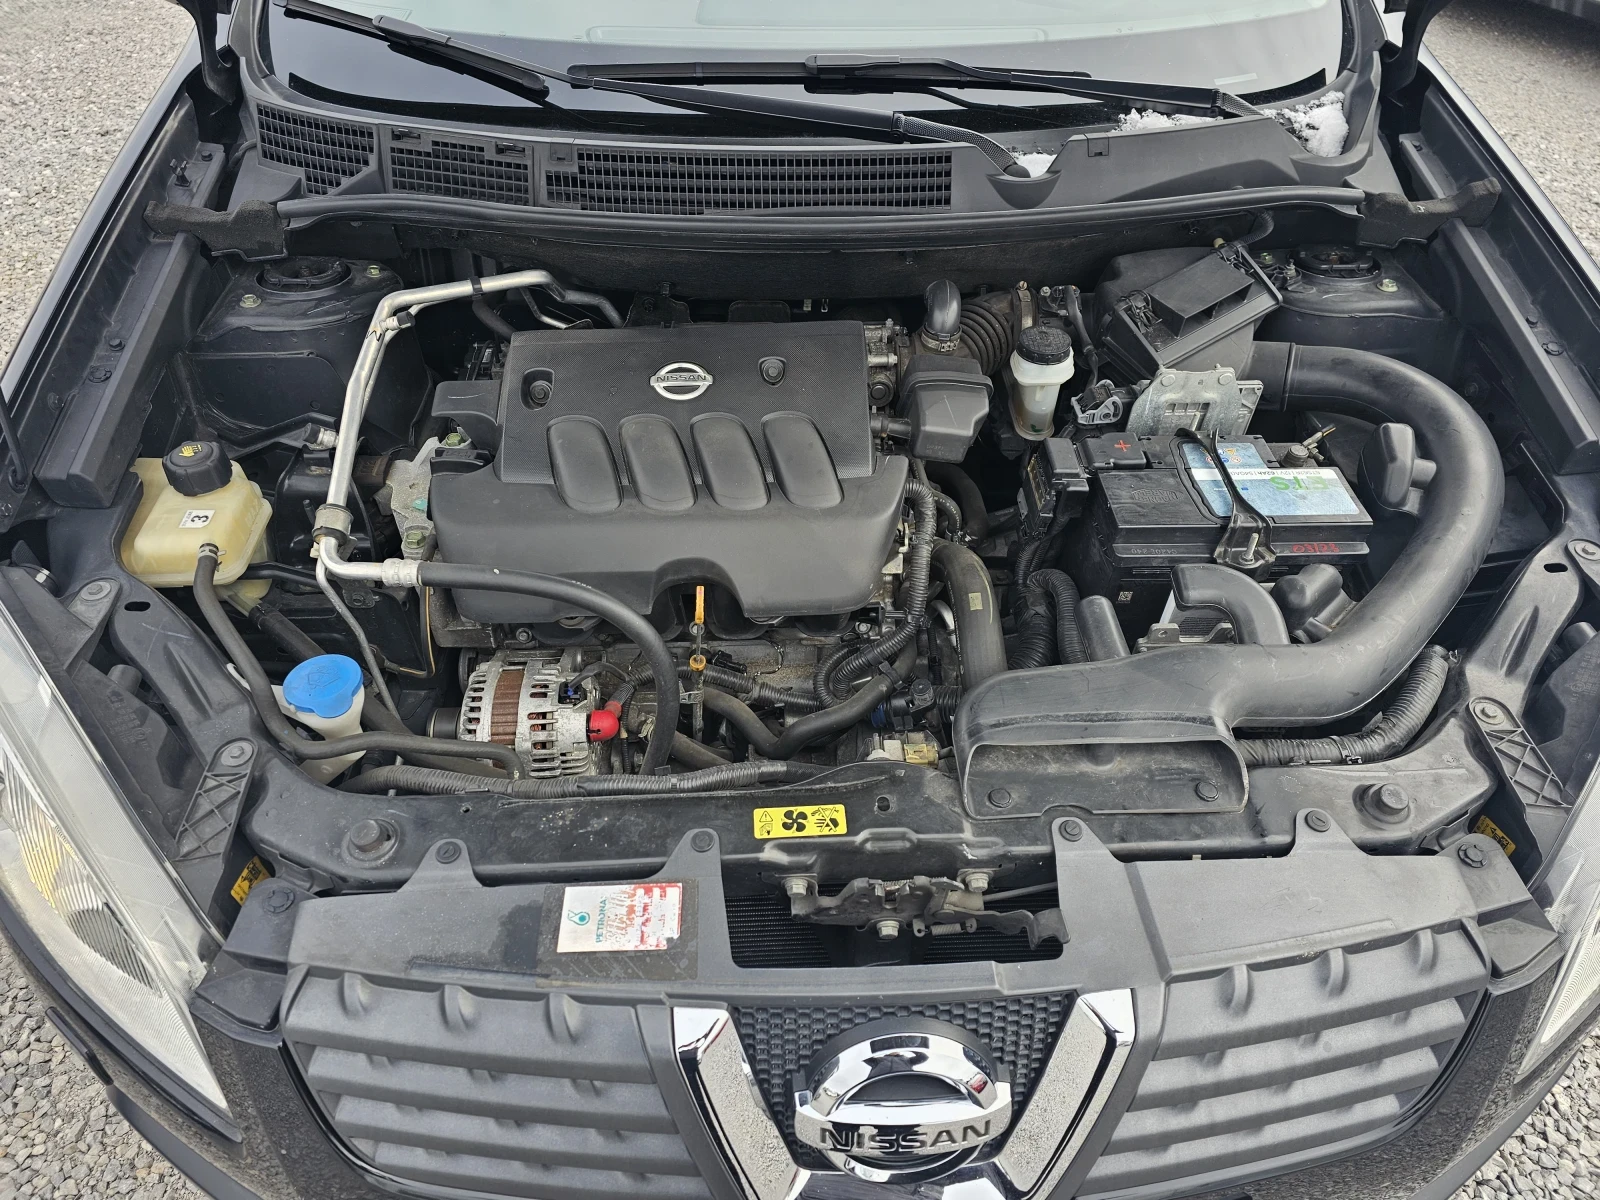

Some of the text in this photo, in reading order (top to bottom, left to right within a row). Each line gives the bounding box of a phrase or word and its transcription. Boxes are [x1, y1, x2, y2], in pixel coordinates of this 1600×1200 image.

[656, 374, 707, 382] NISSAN
[190, 514, 210, 523] 3
[595, 896, 608, 943] PETRONA
[818, 1118, 992, 1152] NISSAN
